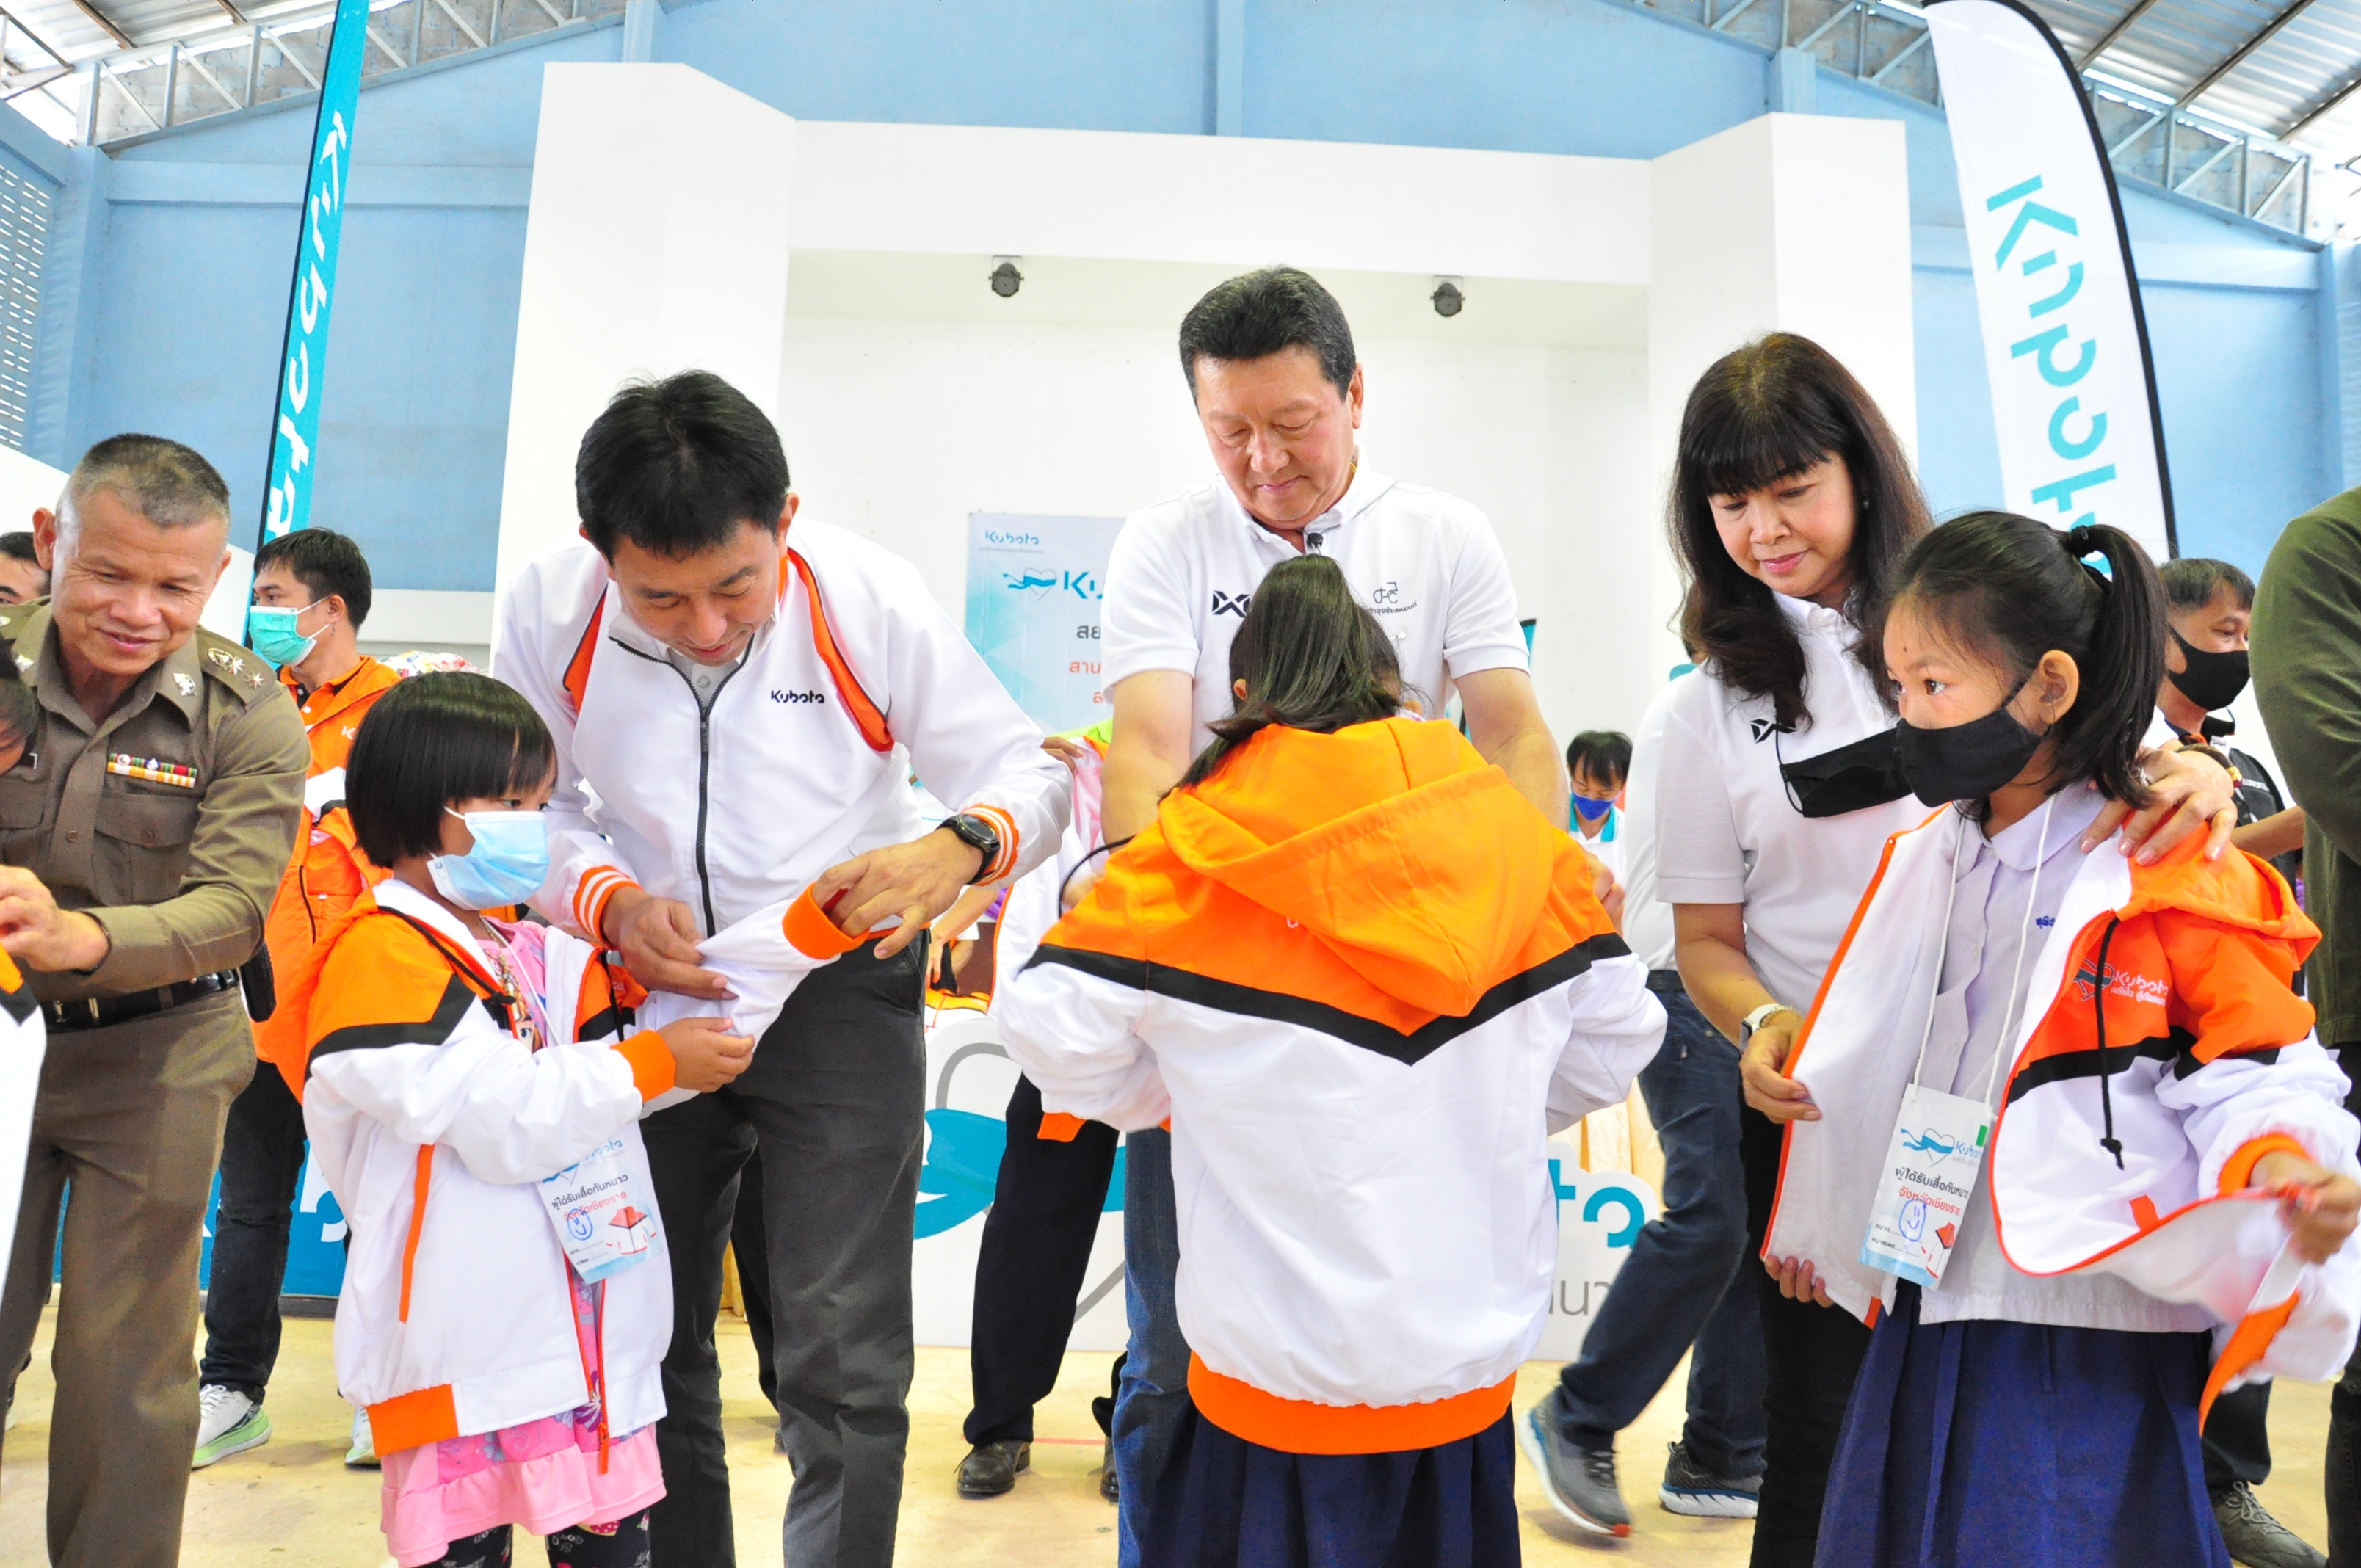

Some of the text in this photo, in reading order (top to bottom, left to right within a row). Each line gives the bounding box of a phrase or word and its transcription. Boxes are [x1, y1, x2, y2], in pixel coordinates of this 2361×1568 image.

[984, 531, 1040, 545] Kubota
[771, 690, 825, 703] Kubota
[551, 1174, 628, 1211] ผู้ได้รับเสื้อกันหนาว
